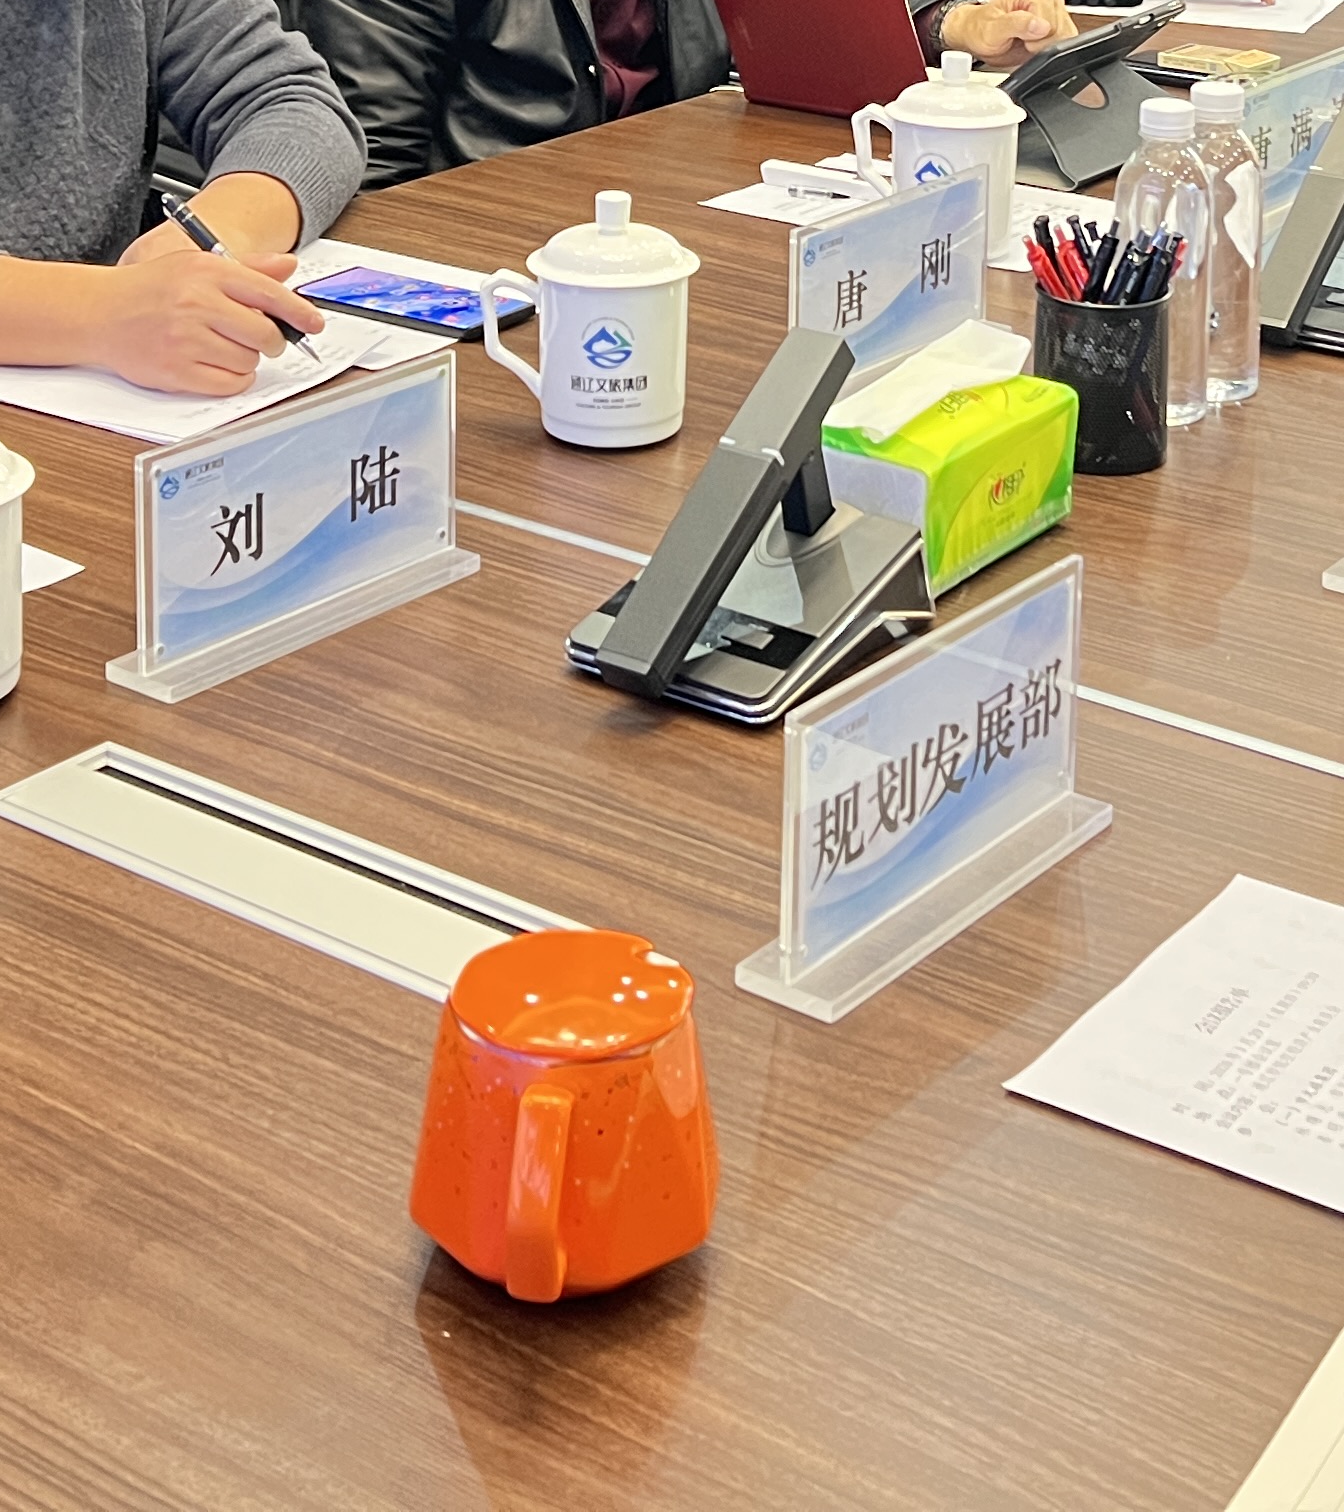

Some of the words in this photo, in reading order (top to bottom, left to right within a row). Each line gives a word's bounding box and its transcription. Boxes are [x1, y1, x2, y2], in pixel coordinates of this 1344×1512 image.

[832, 232, 953, 331] 唐刚
[209, 445, 400, 577] 刘陆
[810, 658, 1064, 893] 规划发展部
